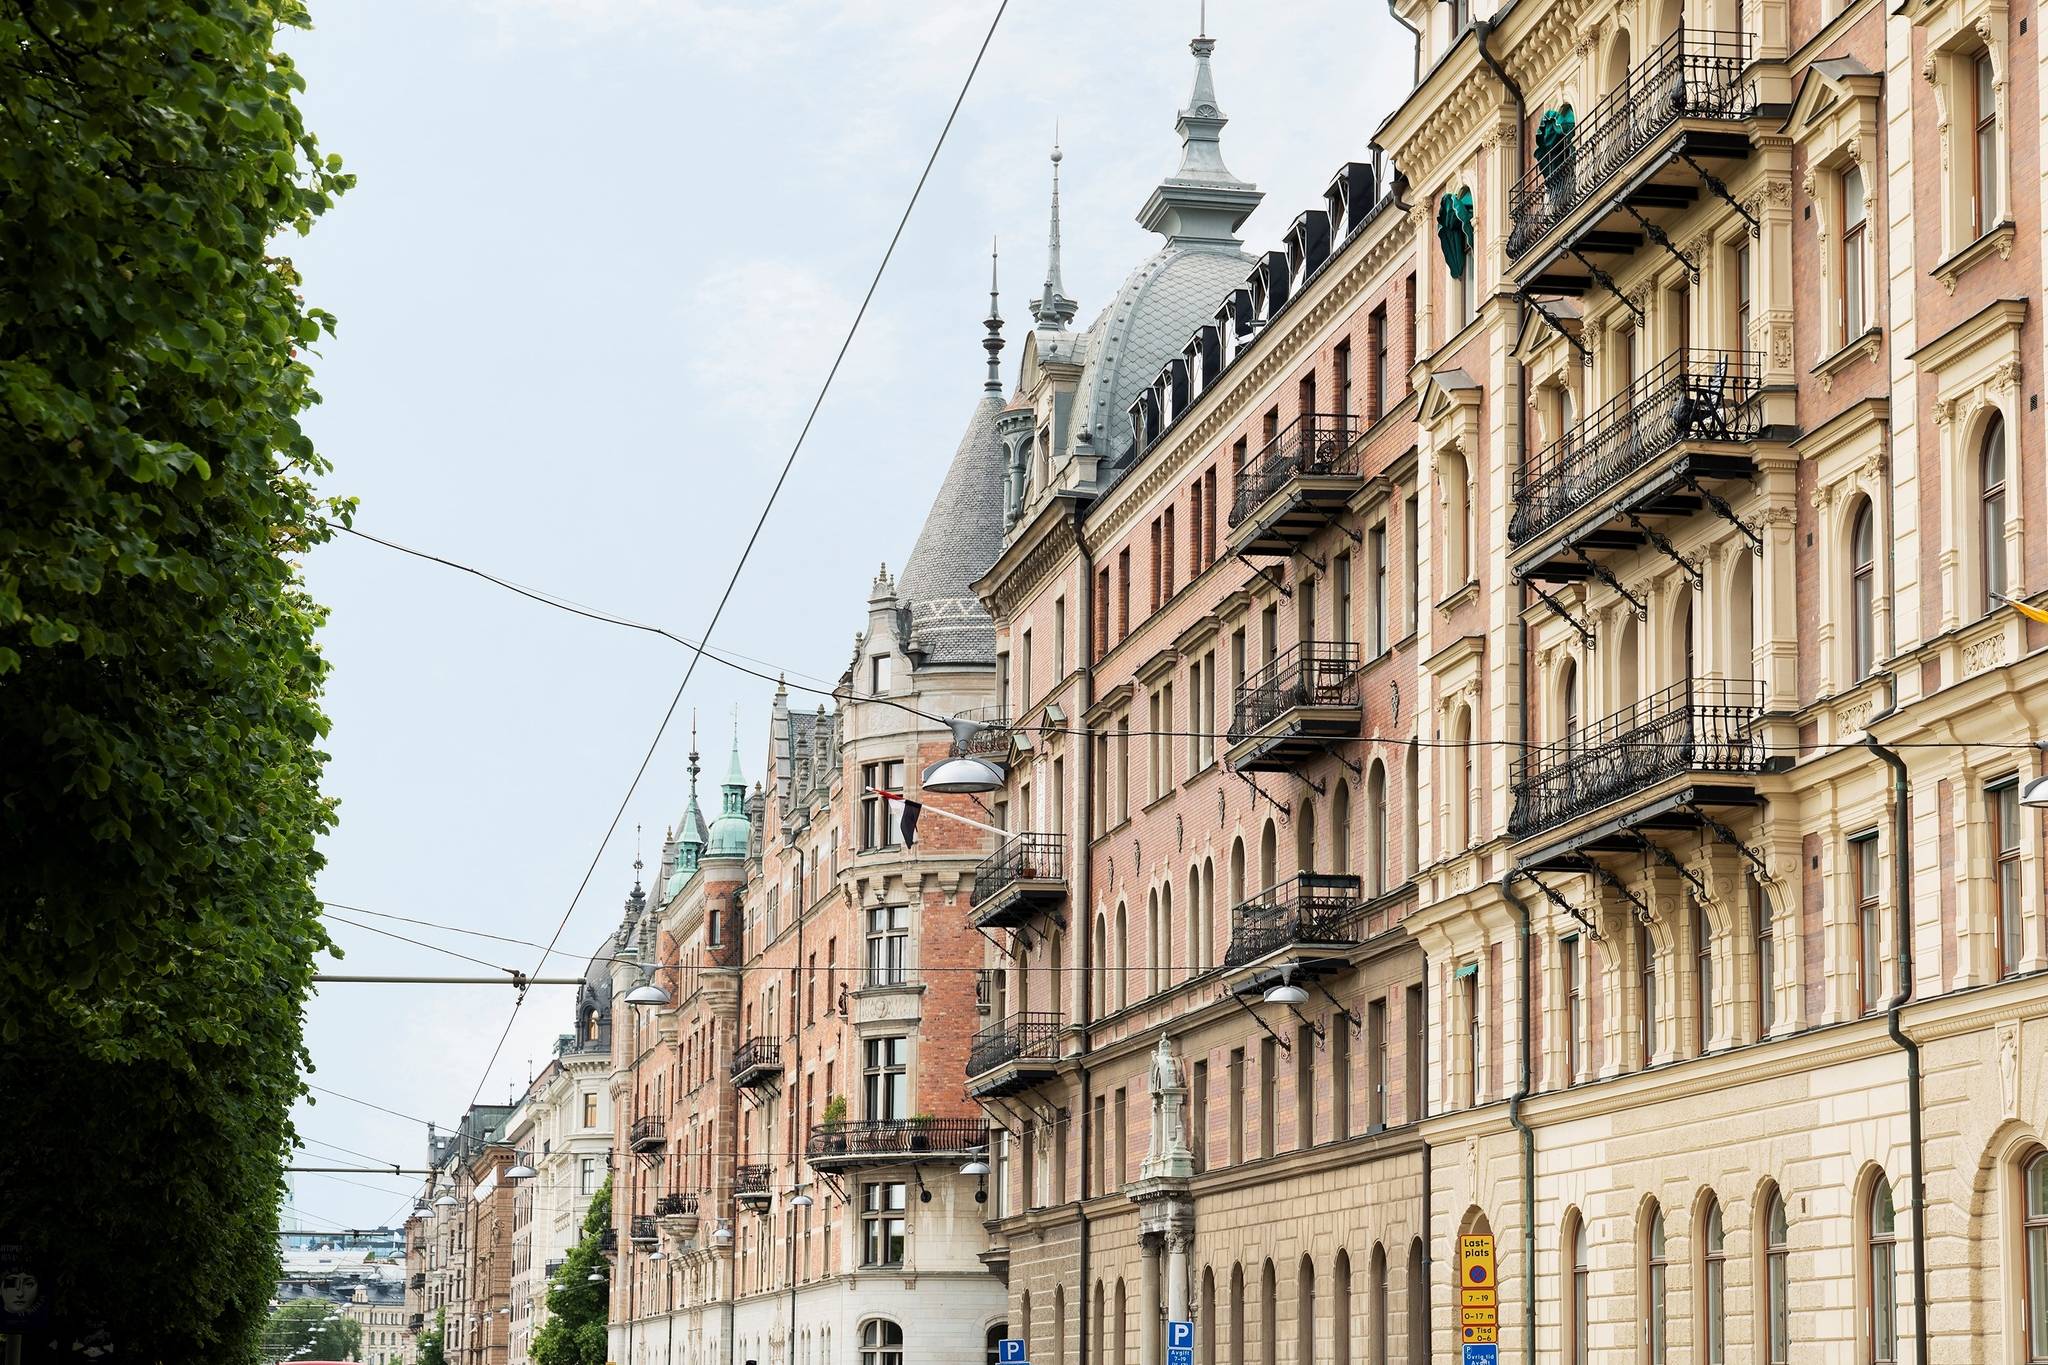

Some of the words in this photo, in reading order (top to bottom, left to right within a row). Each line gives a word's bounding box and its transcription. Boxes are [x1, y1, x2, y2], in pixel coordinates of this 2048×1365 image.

[1464, 1239, 1489, 1247] Last-
[1466, 1249, 1489, 1258] plats
[1174, 1324, 1189, 1345] P
[1007, 1342, 1020, 1360] P
